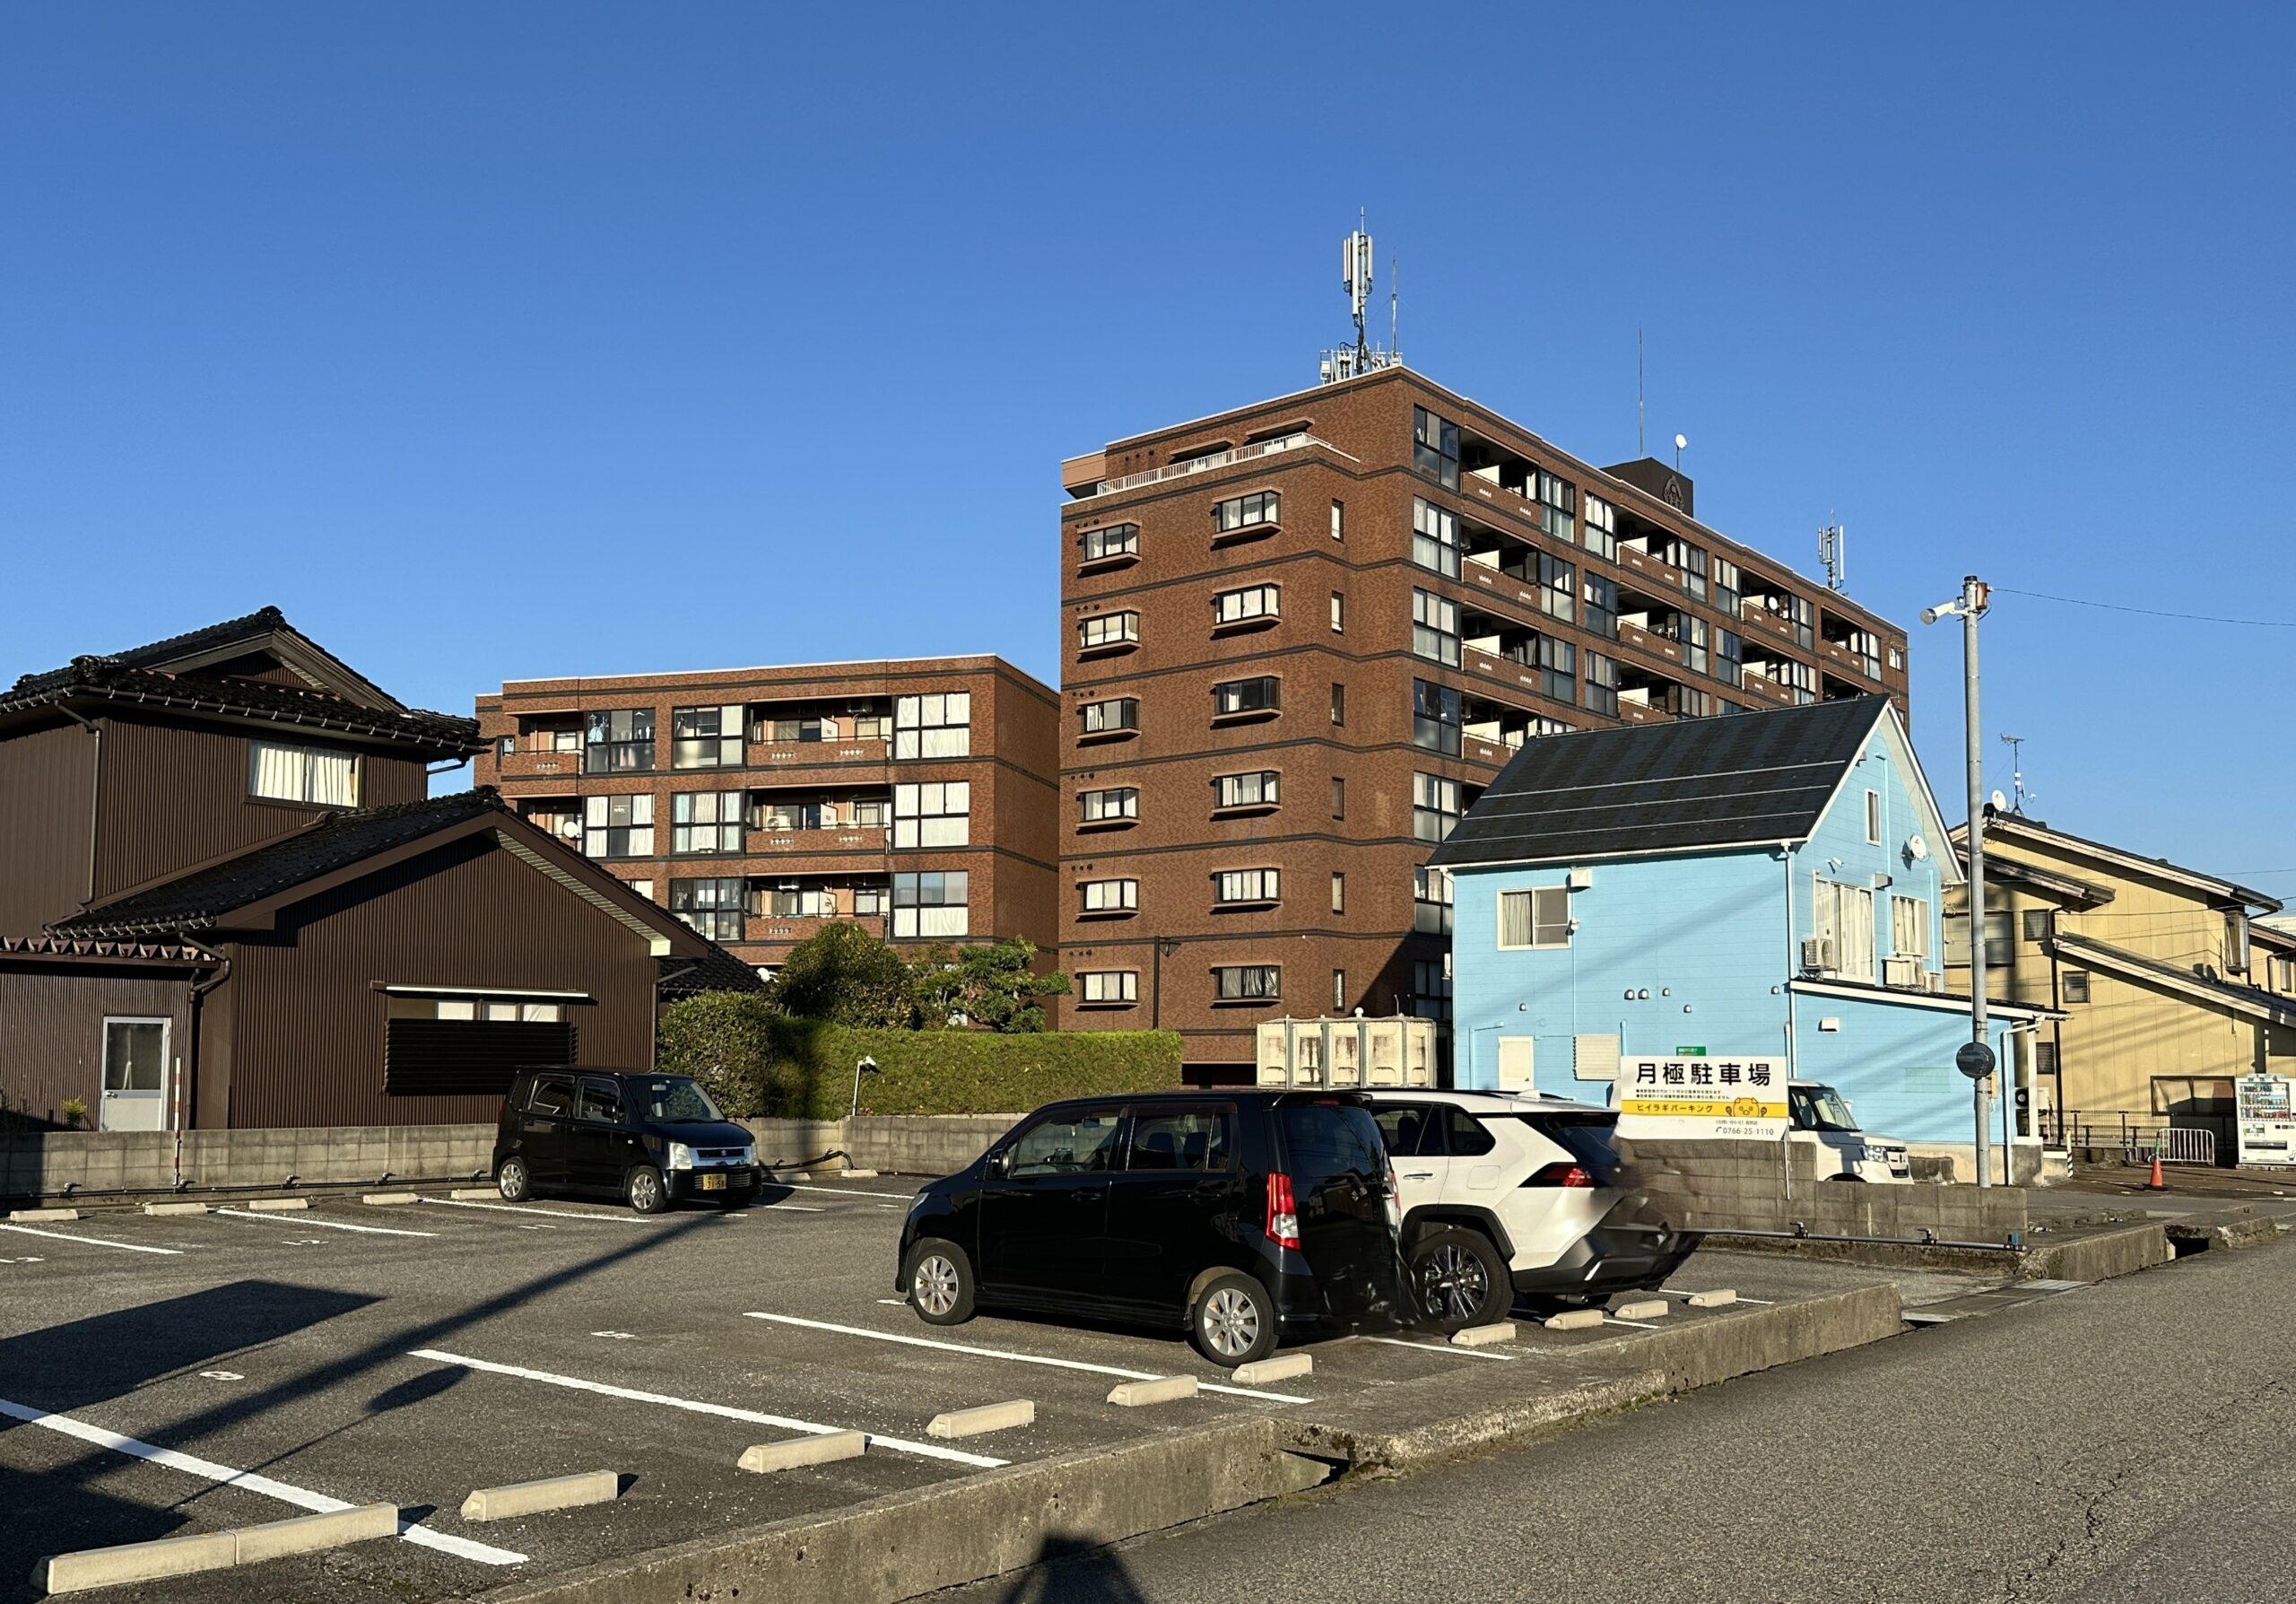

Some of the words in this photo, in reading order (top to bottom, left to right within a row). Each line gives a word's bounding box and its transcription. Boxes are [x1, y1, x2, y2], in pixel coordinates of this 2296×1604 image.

[1637, 1062, 1771, 1086] 月極駐車場
